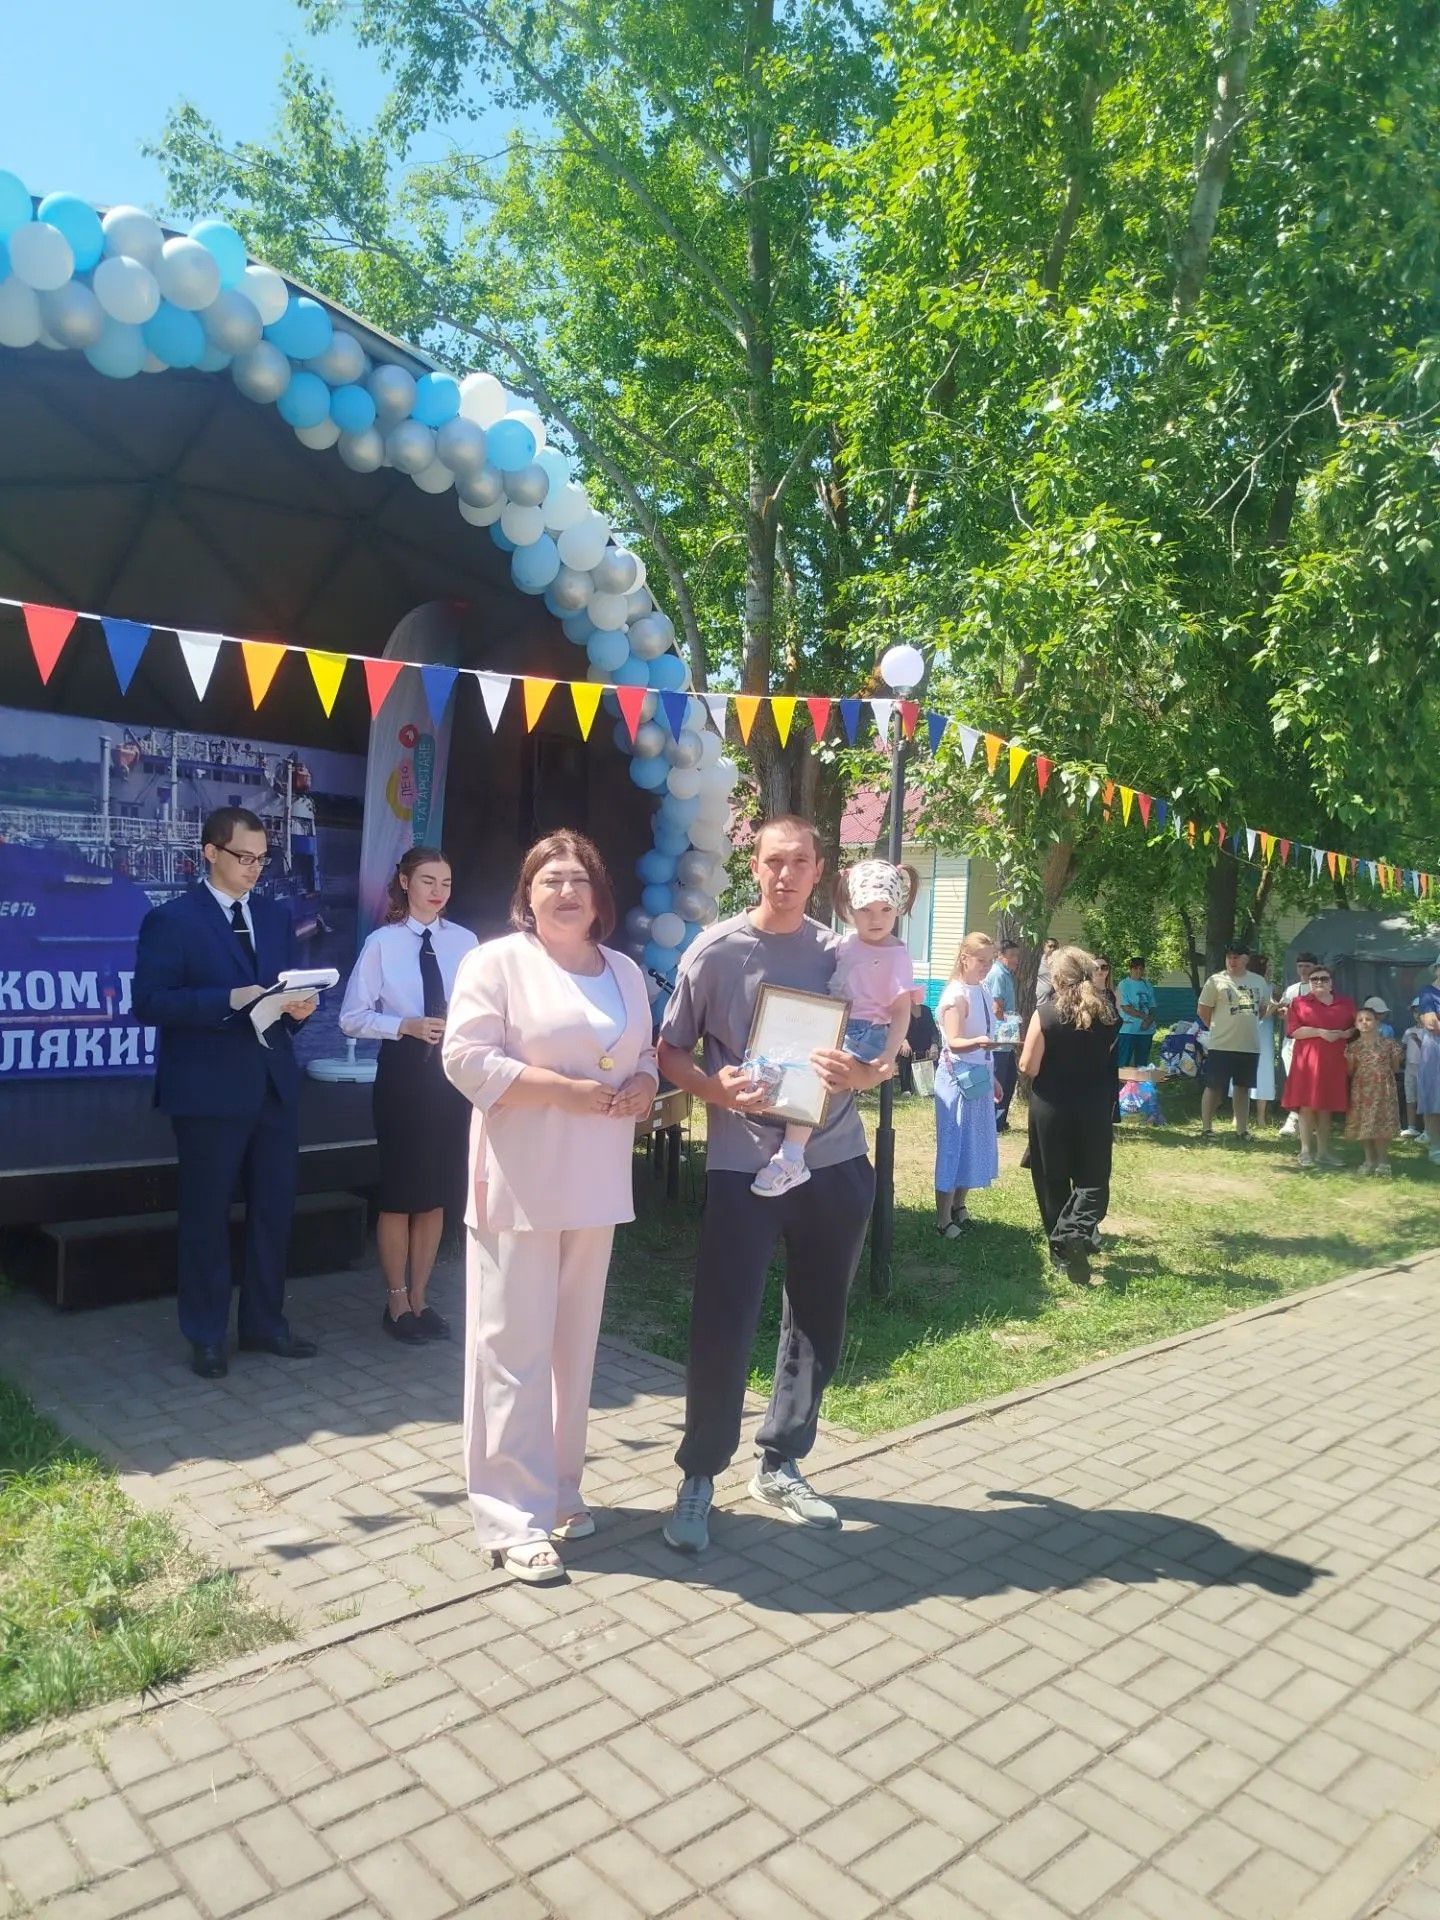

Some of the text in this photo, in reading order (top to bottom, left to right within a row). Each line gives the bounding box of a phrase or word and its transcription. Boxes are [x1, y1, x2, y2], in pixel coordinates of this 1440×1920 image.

[401, 766, 412, 796] ЛЕТО
[417, 743, 431, 823] ТАТАРСТАНЕ
[0, 901, 36, 917] ЕФТЬ
[0, 970, 100, 1010] КОМ
[0, 1026, 156, 1071] ЛЯКИ!
